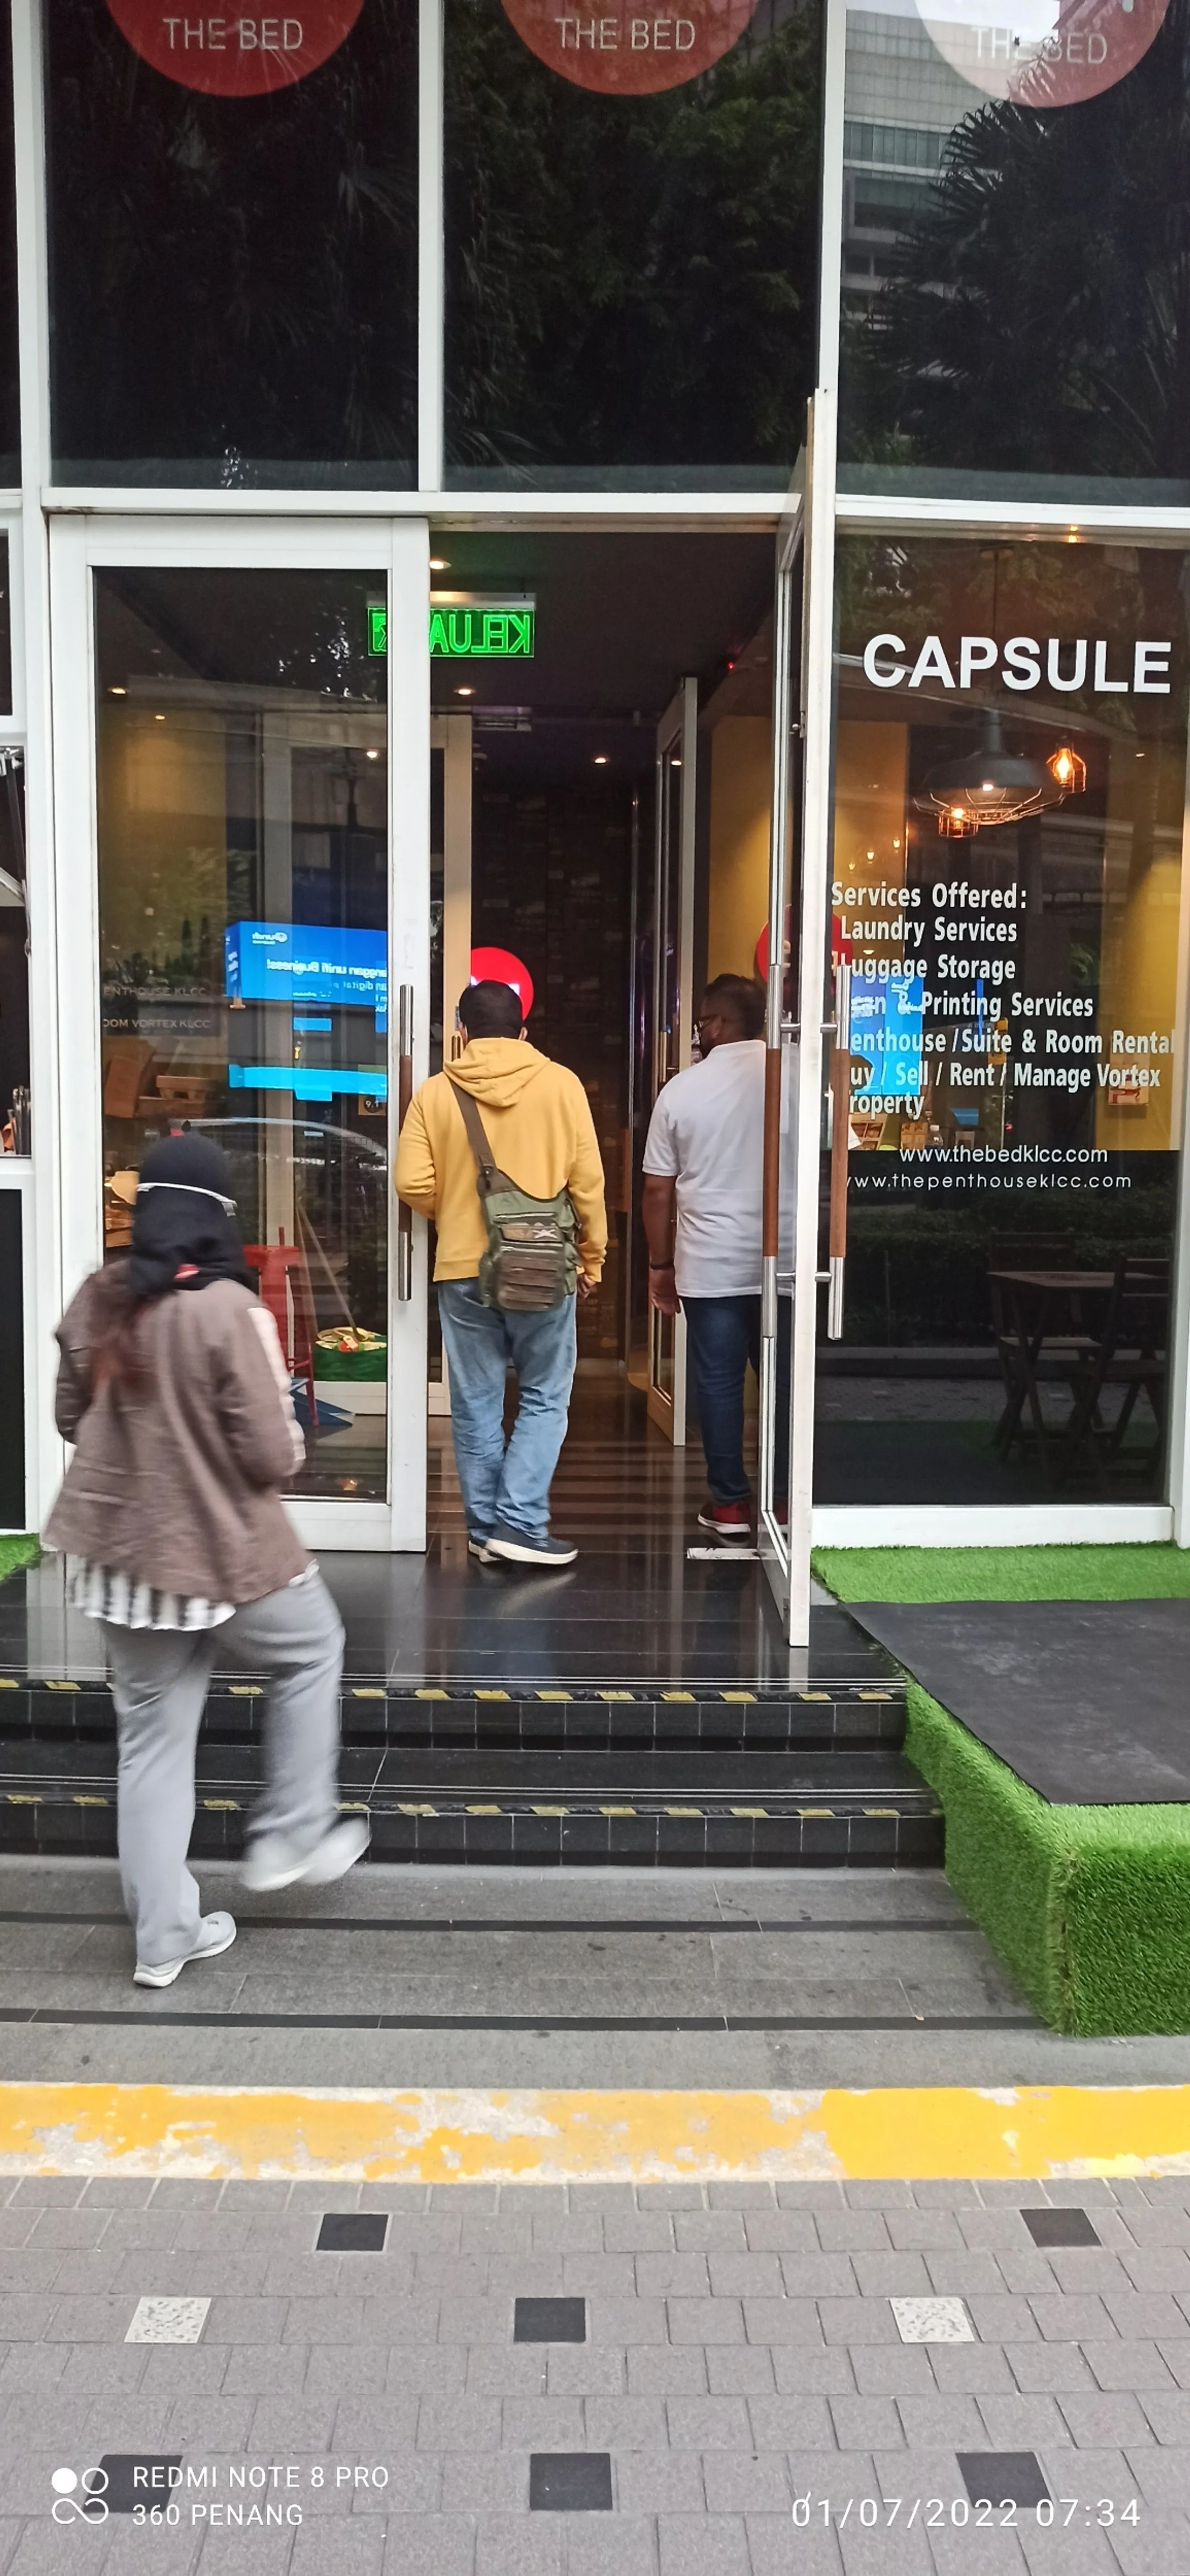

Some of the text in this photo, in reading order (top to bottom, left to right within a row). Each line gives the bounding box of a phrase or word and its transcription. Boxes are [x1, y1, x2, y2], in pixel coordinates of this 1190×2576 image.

[162, 18, 304, 50] THE BED
[555, 18, 696, 51] THE BED
[972, 27, 1108, 64] THE BED
[863, 634, 1171, 693] CAPSULE
[831, 881, 1026, 908] Services Offered:
[841, 915, 1017, 947] Laundry Services
[937, 954, 1015, 986] Storage
[104, 987, 171, 996] ENTHOUSE
[922, 990, 1002, 1022] Printing
[1012, 992, 1093, 1016] Services
[103, 1019, 211, 1028] OOM VORTEX KLCC
[851, 1026, 947, 1052] enthouse
[1021, 1029, 1036, 1054] &
[1046, 1029, 1102, 1054] Room
[1112, 1029, 1175, 1054] Rental
[851, 1067, 875, 1092] uy
[895, 1061, 928, 1086] Sell
[935, 1062, 943, 1086] /
[950, 1062, 994, 1087] Rent
[1000, 1062, 1007, 1087] /
[1014, 1063, 1091, 1093] Manage
[1097, 1064, 1161, 1087] Vortex
[849, 1091, 925, 1120] roperty
[899, 1144, 1108, 1163] www.thebedklcc.com
